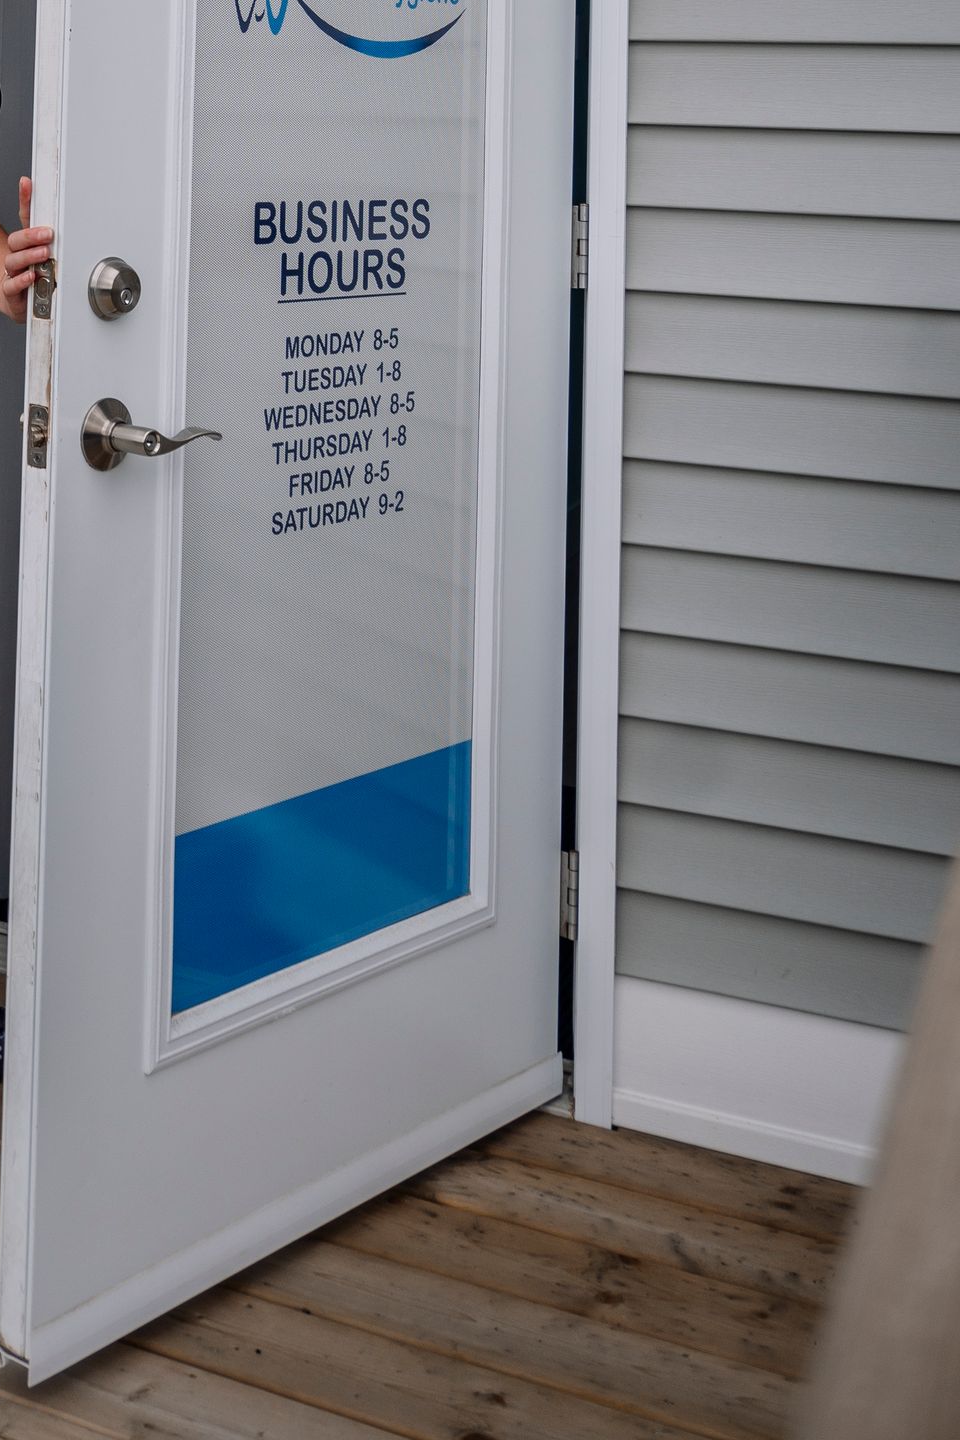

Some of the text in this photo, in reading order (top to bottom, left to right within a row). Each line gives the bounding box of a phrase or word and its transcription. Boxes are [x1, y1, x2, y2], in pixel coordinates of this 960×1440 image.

[253, 198, 431, 245] BUSINESS
[280, 247, 406, 297] HOURS
[285, 327, 399, 360] MONDAY 8-5
[281, 360, 402, 394] TUESDAY 1-8
[263, 390, 415, 432] WEDNESDAY 8-5
[271, 424, 407, 465] THURSDAY 1-8
[289, 459, 390, 498] FRIDAY 8-5
[271, 490, 404, 536] SATURDAY 9-2
